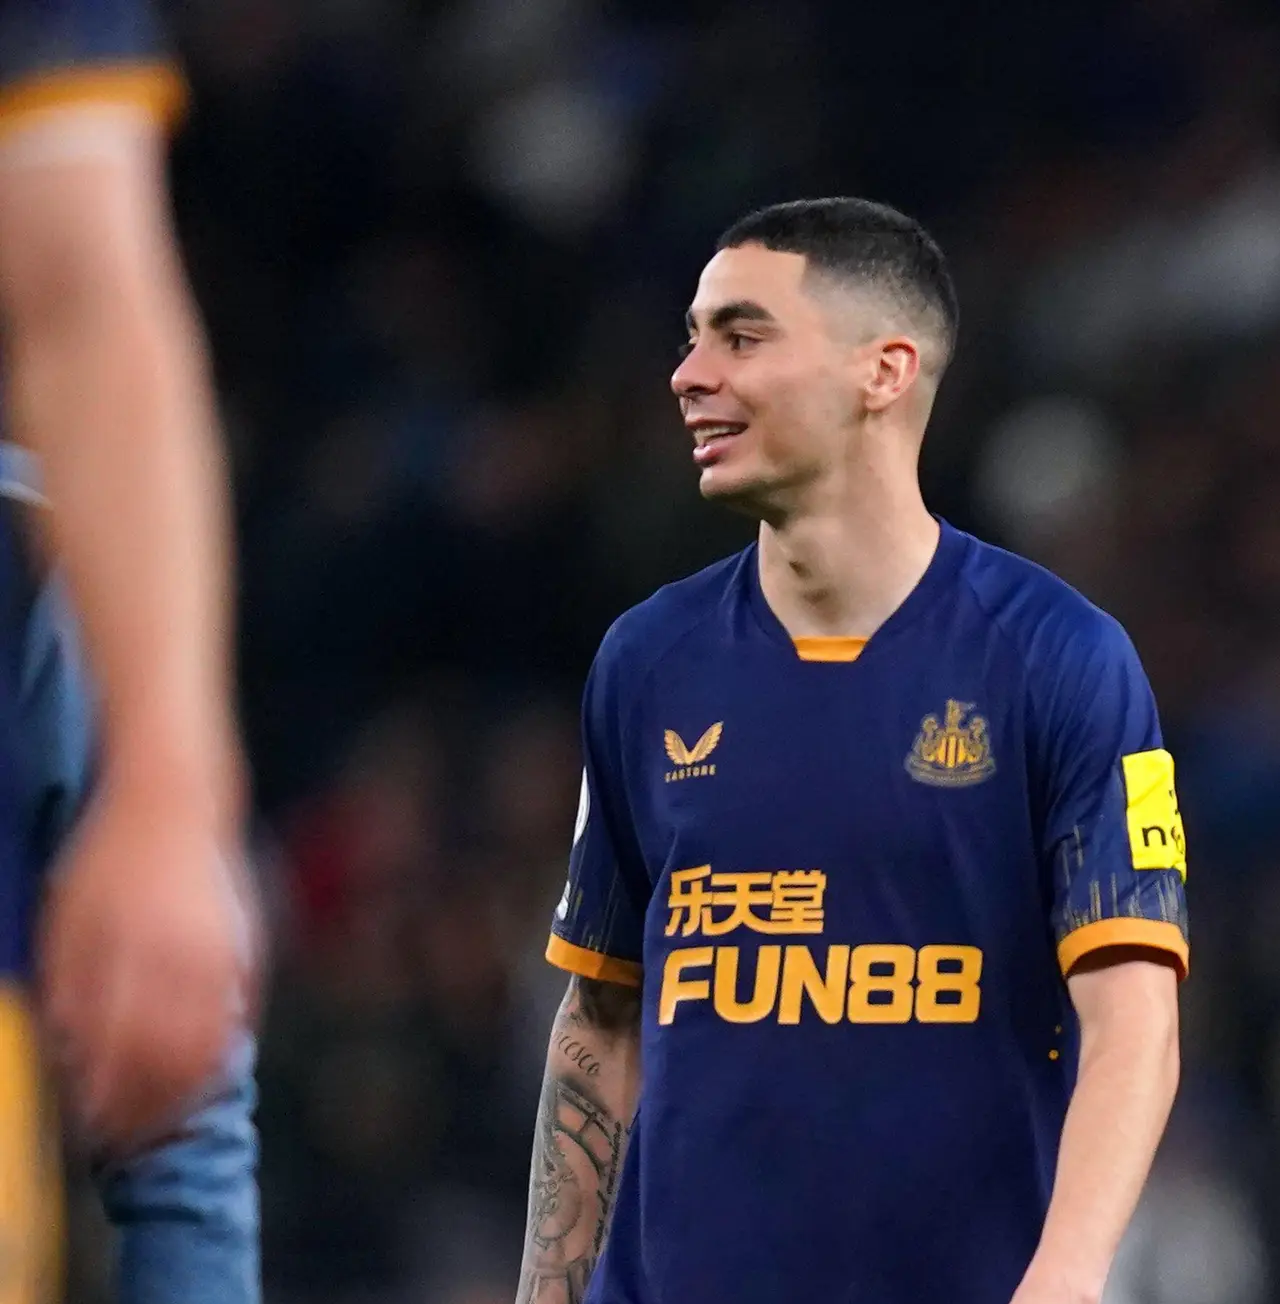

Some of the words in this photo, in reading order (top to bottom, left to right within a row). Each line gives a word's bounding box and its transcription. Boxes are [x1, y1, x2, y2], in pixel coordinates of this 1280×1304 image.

[665, 863, 828, 937] 乐天堂
[658, 942, 984, 1026] FUN88
